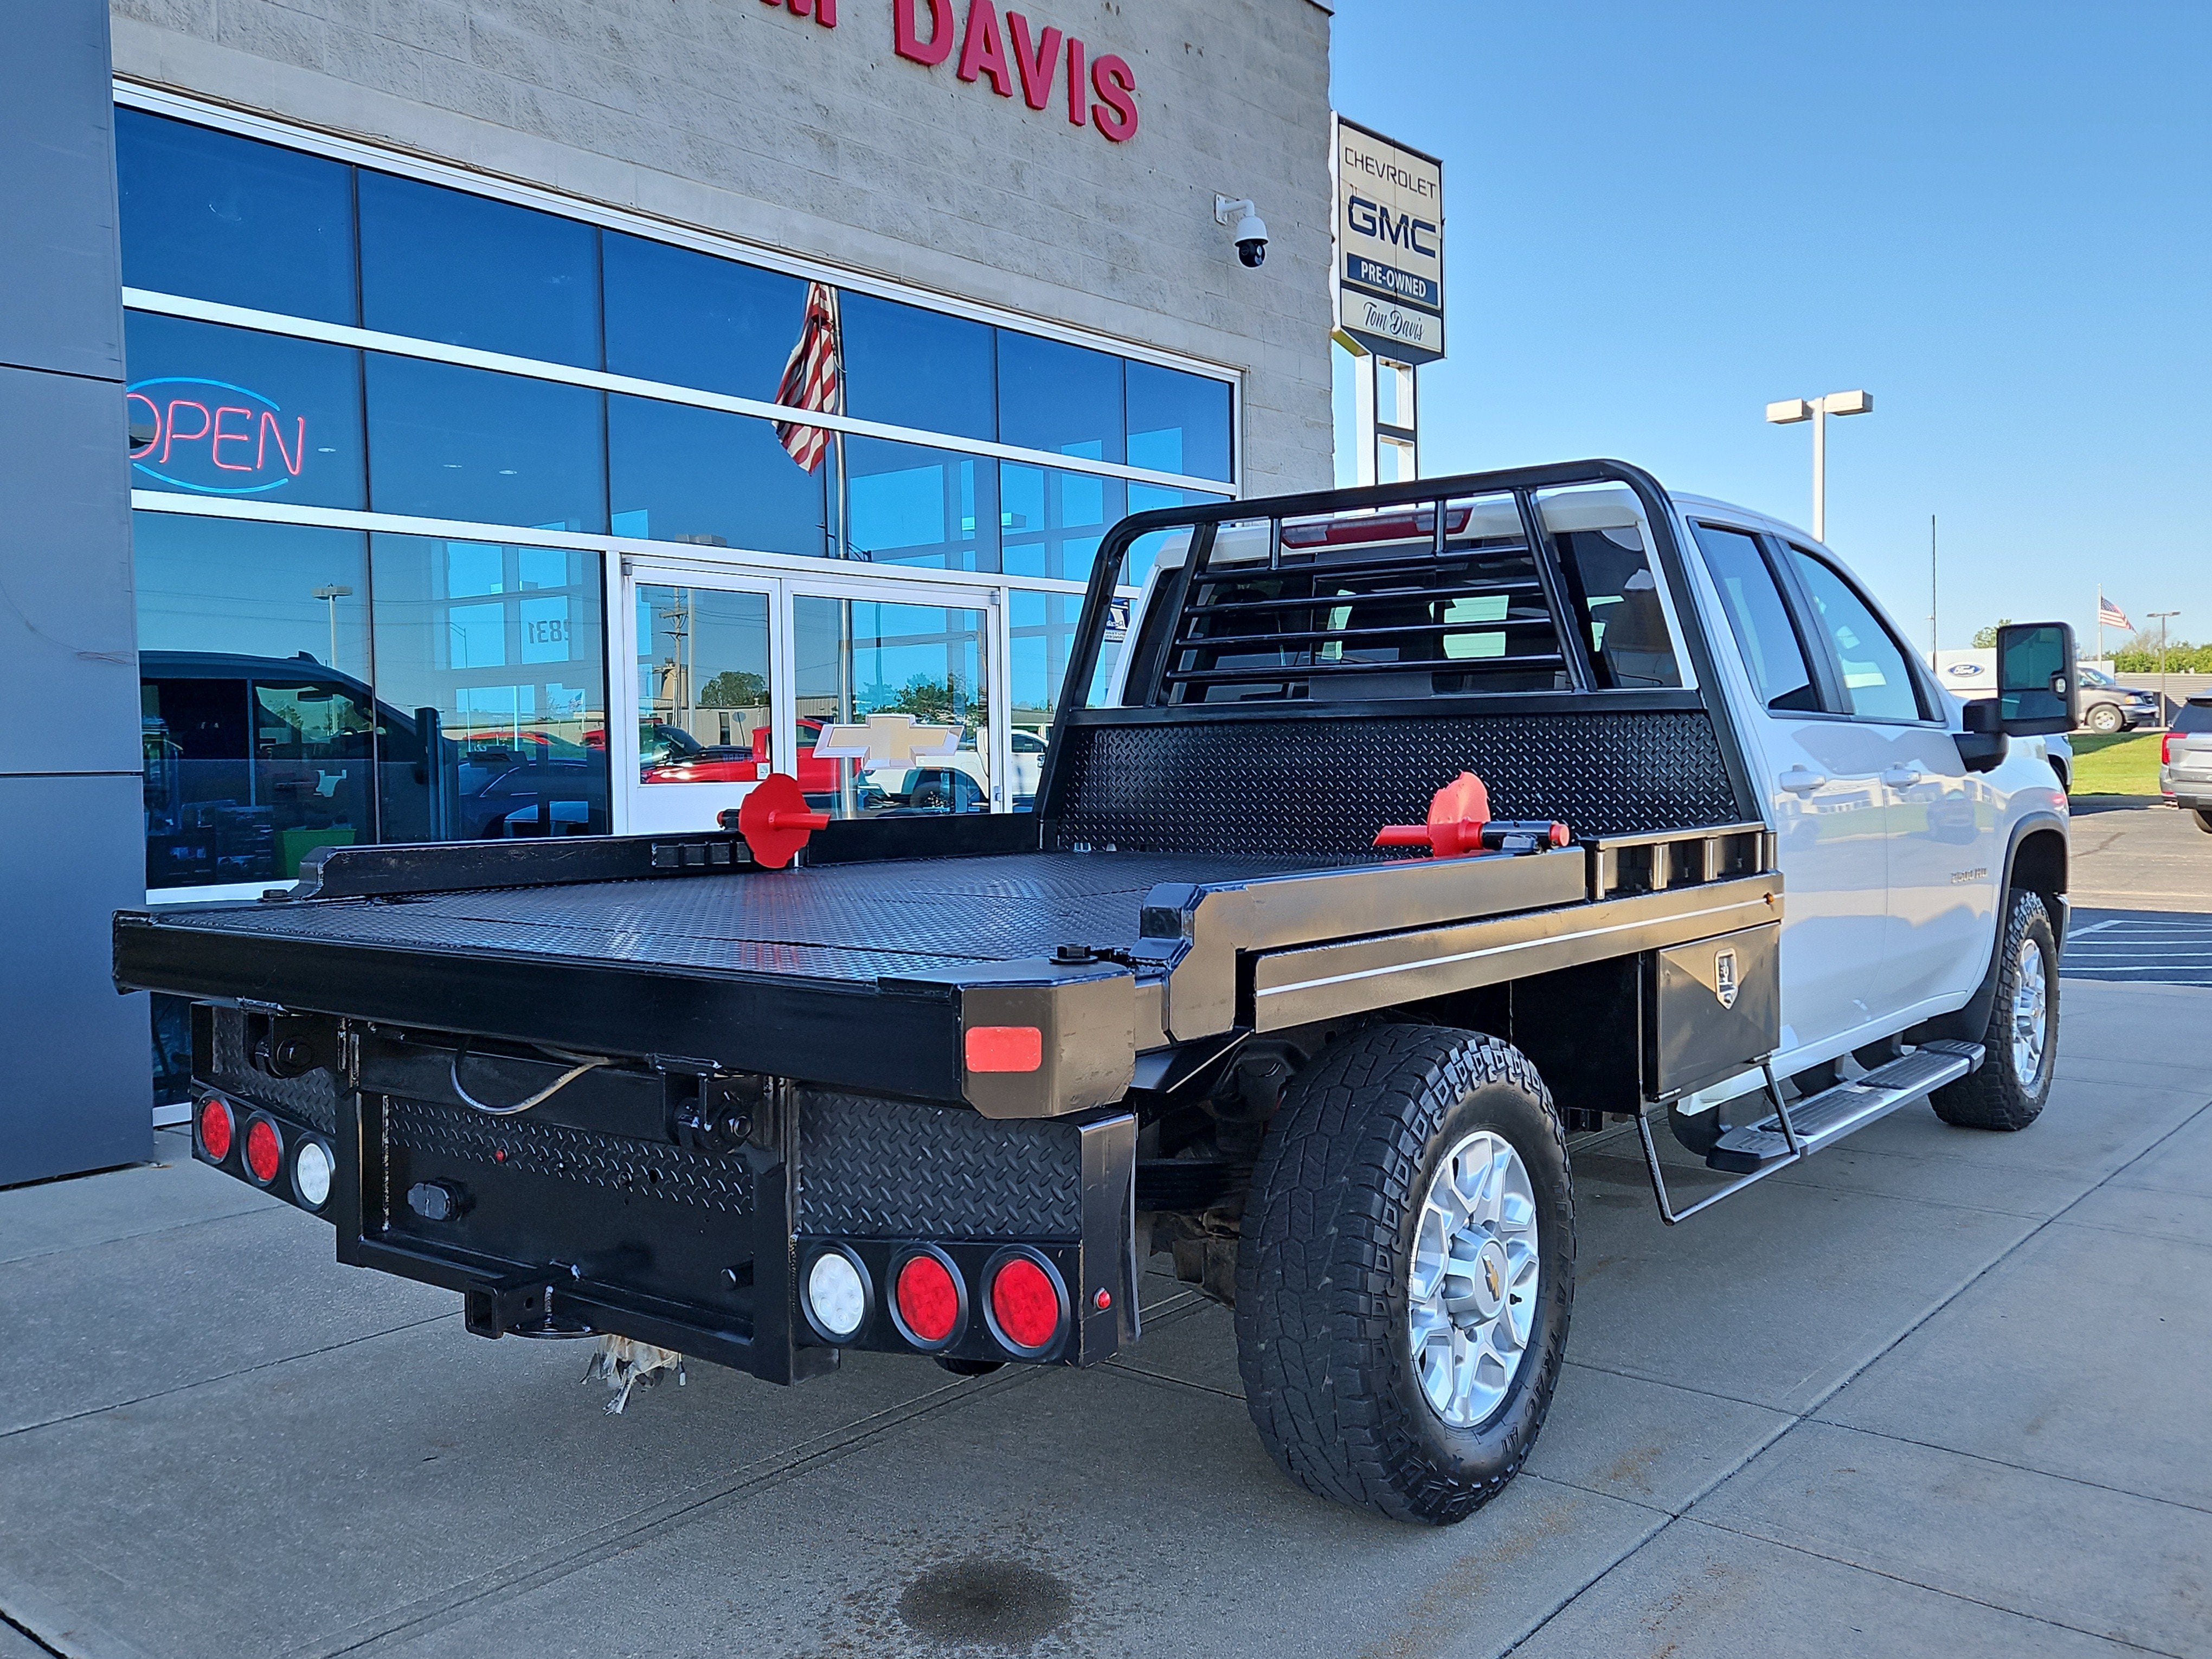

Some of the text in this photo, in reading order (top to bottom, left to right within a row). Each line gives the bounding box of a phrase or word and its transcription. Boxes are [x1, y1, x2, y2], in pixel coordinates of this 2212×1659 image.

[893, 0, 1139, 142] DAVIS
[1345, 146, 1436, 199] CHEVROLET
[1348, 195, 1436, 259] GMC
[1361, 260, 1426, 298] PRE-OWNED
[1363, 301, 1424, 341] Tom Davis
